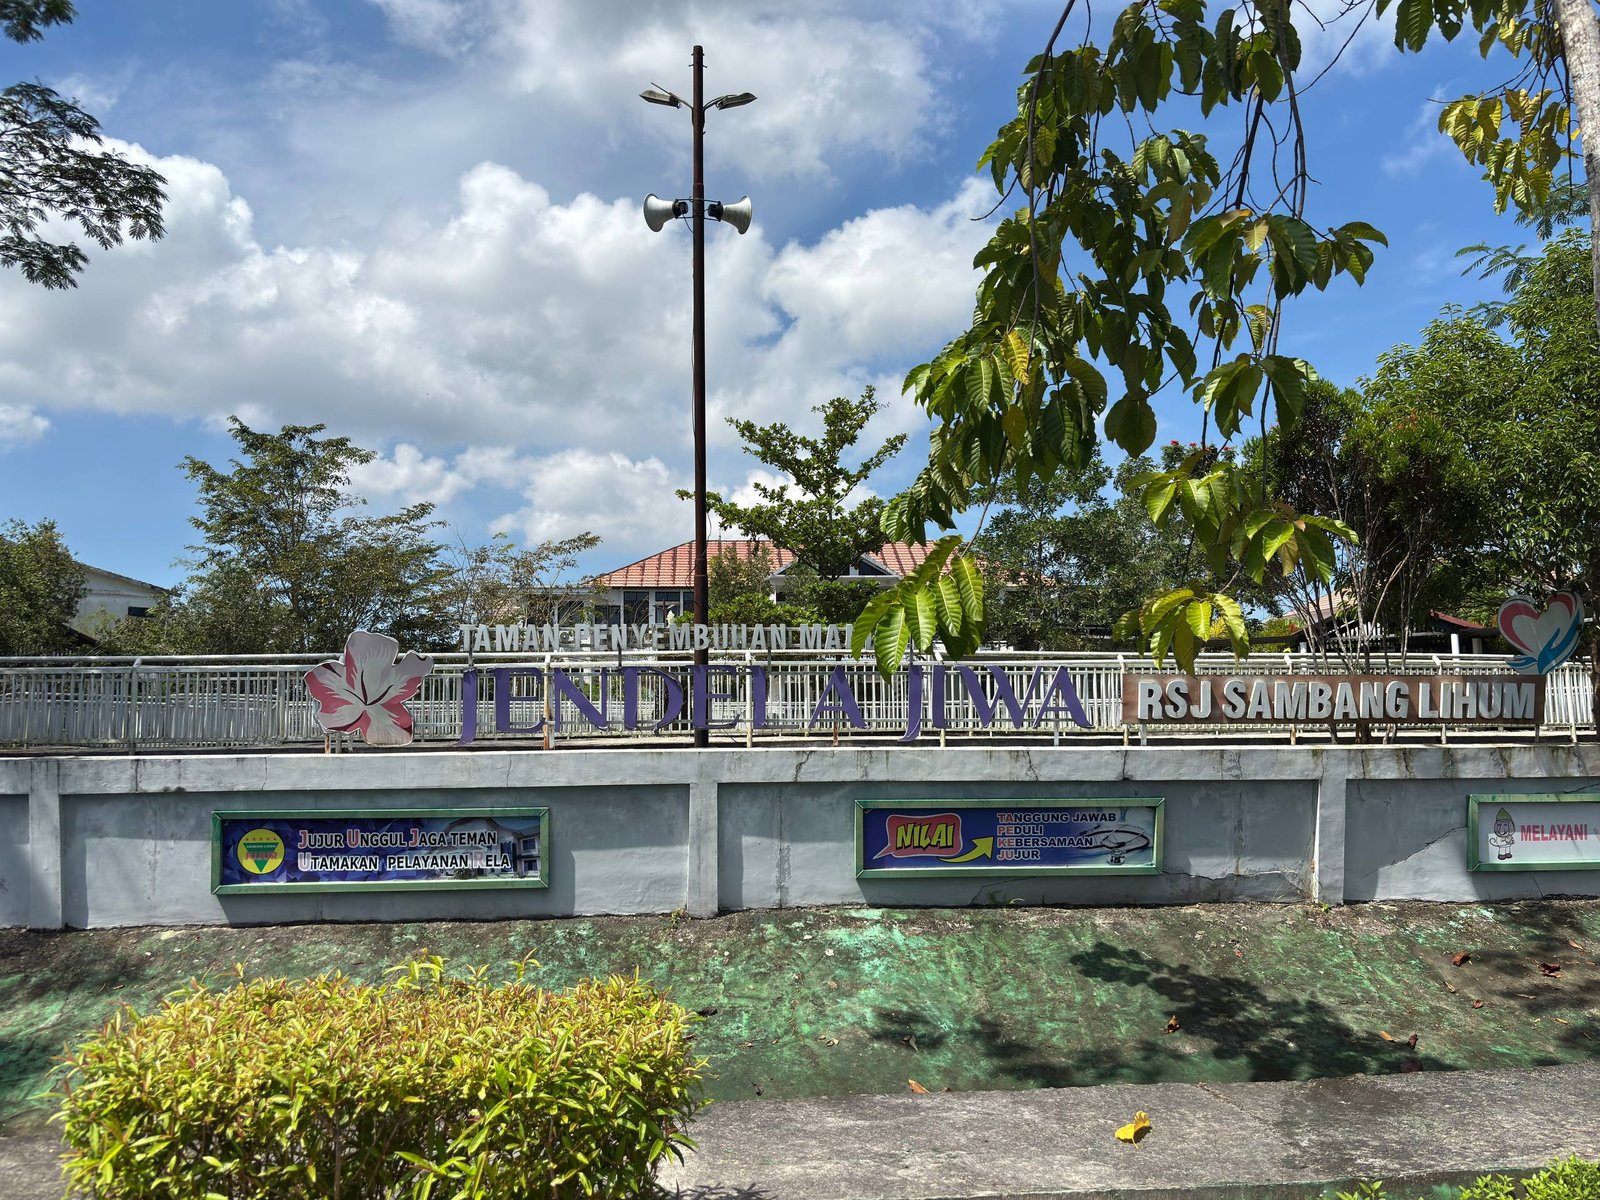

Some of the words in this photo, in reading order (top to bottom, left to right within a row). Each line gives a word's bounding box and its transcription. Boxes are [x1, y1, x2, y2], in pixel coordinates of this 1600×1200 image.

[460, 623, 560, 652] TAMAN
[574, 623, 786, 651] PENYEMBUHAN
[453, 664, 871, 747] JENDELA
[898, 664, 1095, 742] JIWA
[1137, 680, 1212, 720] RSJ
[1221, 680, 1408, 719] SAMBANG
[1418, 681, 1536, 719] LIHUM
[996, 812, 1070, 823] TANGGUNG
[1072, 812, 1117, 822] JAWAB
[299, 830, 345, 848] JUJUR
[347, 829, 407, 848] UNGGUL
[409, 828, 450, 847] JAGA
[450, 831, 498, 846] TEMAN
[896, 823, 955, 850] NILAI
[996, 825, 1043, 835] PEDULI
[1520, 824, 1588, 841] MELAYANI
[996, 837, 1093, 848] KEBERSAMAAN
[299, 853, 378, 871] UTAMAKAN
[387, 854, 470, 869] PELAYANAN
[472, 852, 511, 869] RELA
[996, 849, 1040, 860] JUJUR
